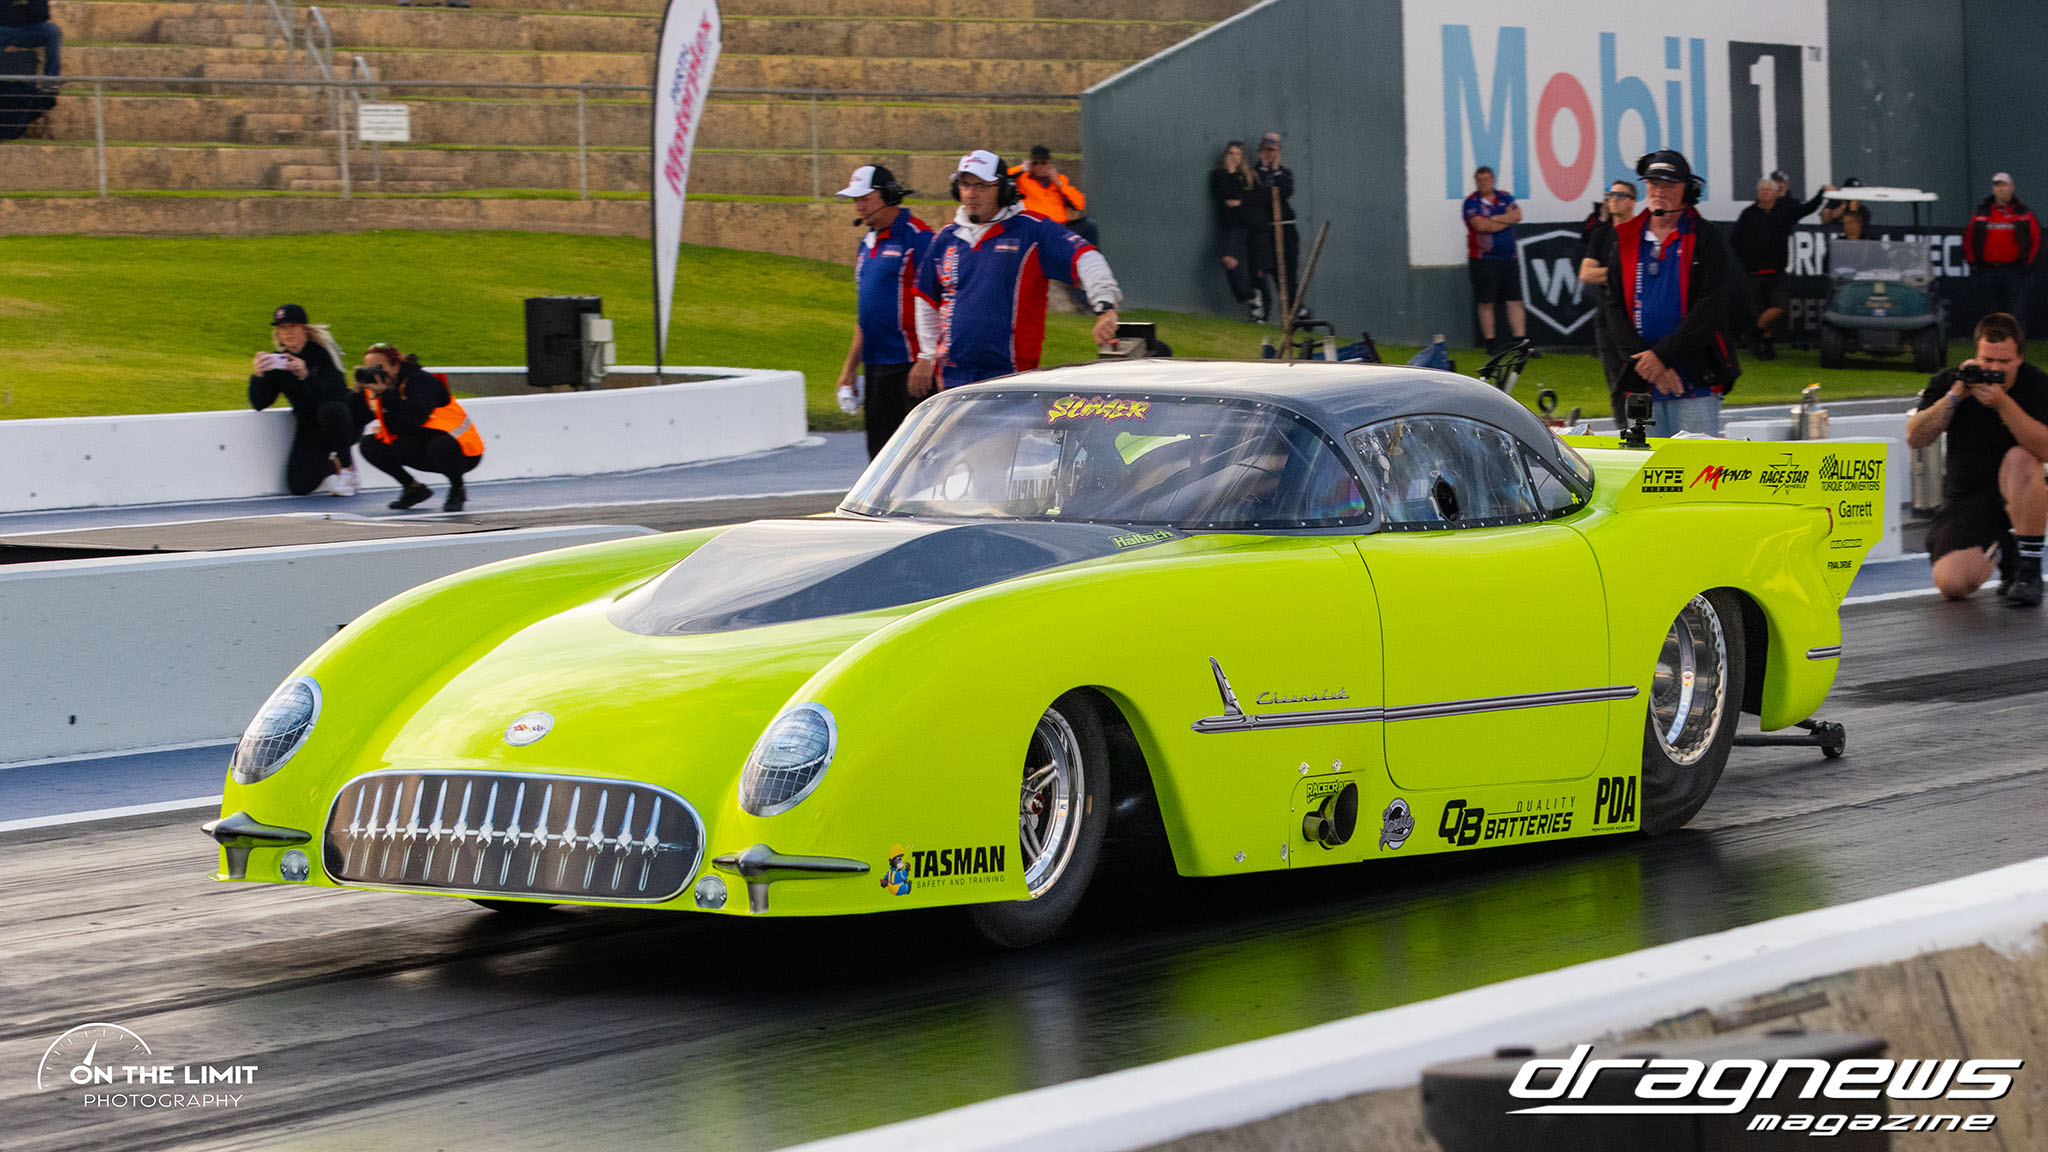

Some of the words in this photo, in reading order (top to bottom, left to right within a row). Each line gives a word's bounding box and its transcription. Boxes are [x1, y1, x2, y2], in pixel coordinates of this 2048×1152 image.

[1441, 24, 1709, 202] Mobil
[1643, 470, 1684, 484] HYPE
[1759, 470, 1786, 484] RACE
[1785, 470, 1809, 484] STAR
[1830, 459, 1883, 480] ALLFAST
[1821, 480, 1843, 492] TORQUE
[1844, 480, 1880, 491] CONVERTERS
[1838, 500, 1872, 518] Garrett
[1112, 529, 1175, 549] Haltech
[1256, 687, 1350, 705] Chevrolet
[1306, 780, 1349, 798] RACECRA
[1516, 796, 1576, 813] QUALITY
[1594, 776, 1636, 825] PDA
[1438, 799, 1485, 847] QB
[1484, 812, 1573, 840] BATTERIES
[912, 845, 1005, 878] TASMAN
[916, 879, 945, 889] SAFETY
[949, 877, 965, 887] AND
[968, 874, 1005, 885] TRAINING
